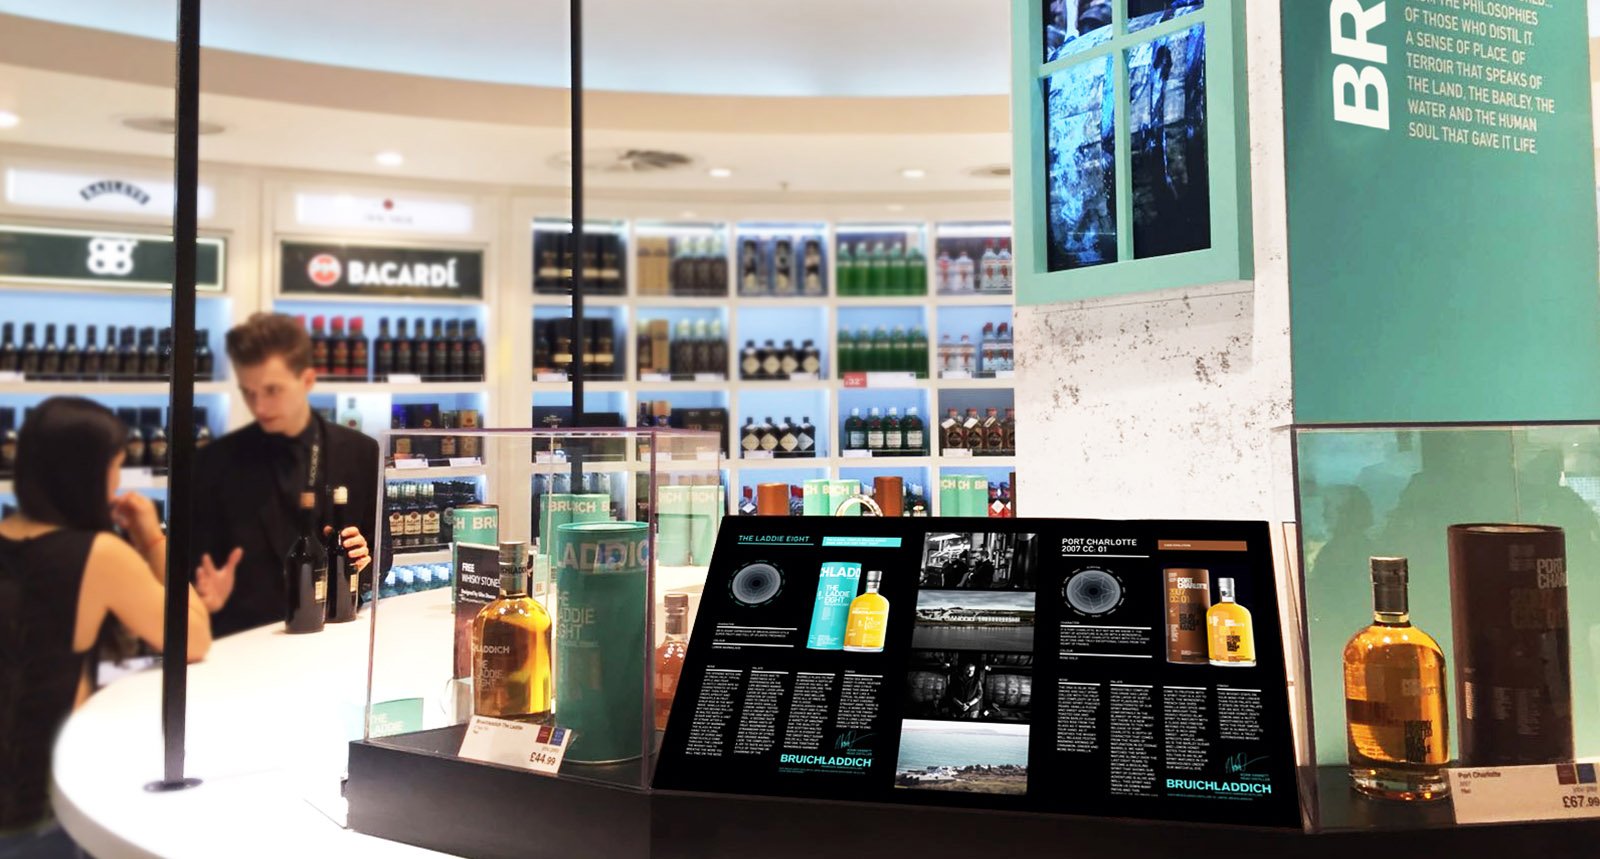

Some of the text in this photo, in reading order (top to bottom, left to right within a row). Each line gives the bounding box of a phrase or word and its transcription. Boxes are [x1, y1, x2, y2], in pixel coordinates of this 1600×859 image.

[1463, 0, 1539, 26] PHILOSOPHIES
[1405, 6, 1420, 23] OF
[1423, 10, 1459, 31] THOSE
[1462, 19, 1487, 37] WHO
[1489, 24, 1522, 44] DISTIL
[1406, 30, 1414, 45] A
[1417, 32, 1453, 52] SENSE
[1456, 39, 1471, 55] OF
[1512, 50, 1526, 65] OF
[1406, 52, 1543, 90] TERROIR THAT SPEAKS OF
[1407, 75, 1429, 94] THE
[1468, 85, 1490, 103] THE
[1535, 97, 1556, 114] THE
[1408, 99, 1538, 132] WATER AND THE HUMAN
[1409, 122, 1439, 141] SOUL
[1441, 126, 1469, 145] THAT
[1472, 131, 1499, 149] GAVE
[1502, 135, 1513, 150] IT
[755, 535, 784, 543] LADDIE
[1061, 545, 1081, 553] 2007
[1062, 538, 1138, 547] PORT CHARLOTTE
[462, 562, 475, 573] FREE
[530, 751, 557, 767] £44.99
[780, 753, 872, 768] BRUICHLADDICH
[1166, 778, 1272, 794] BRUICHLADDICH
